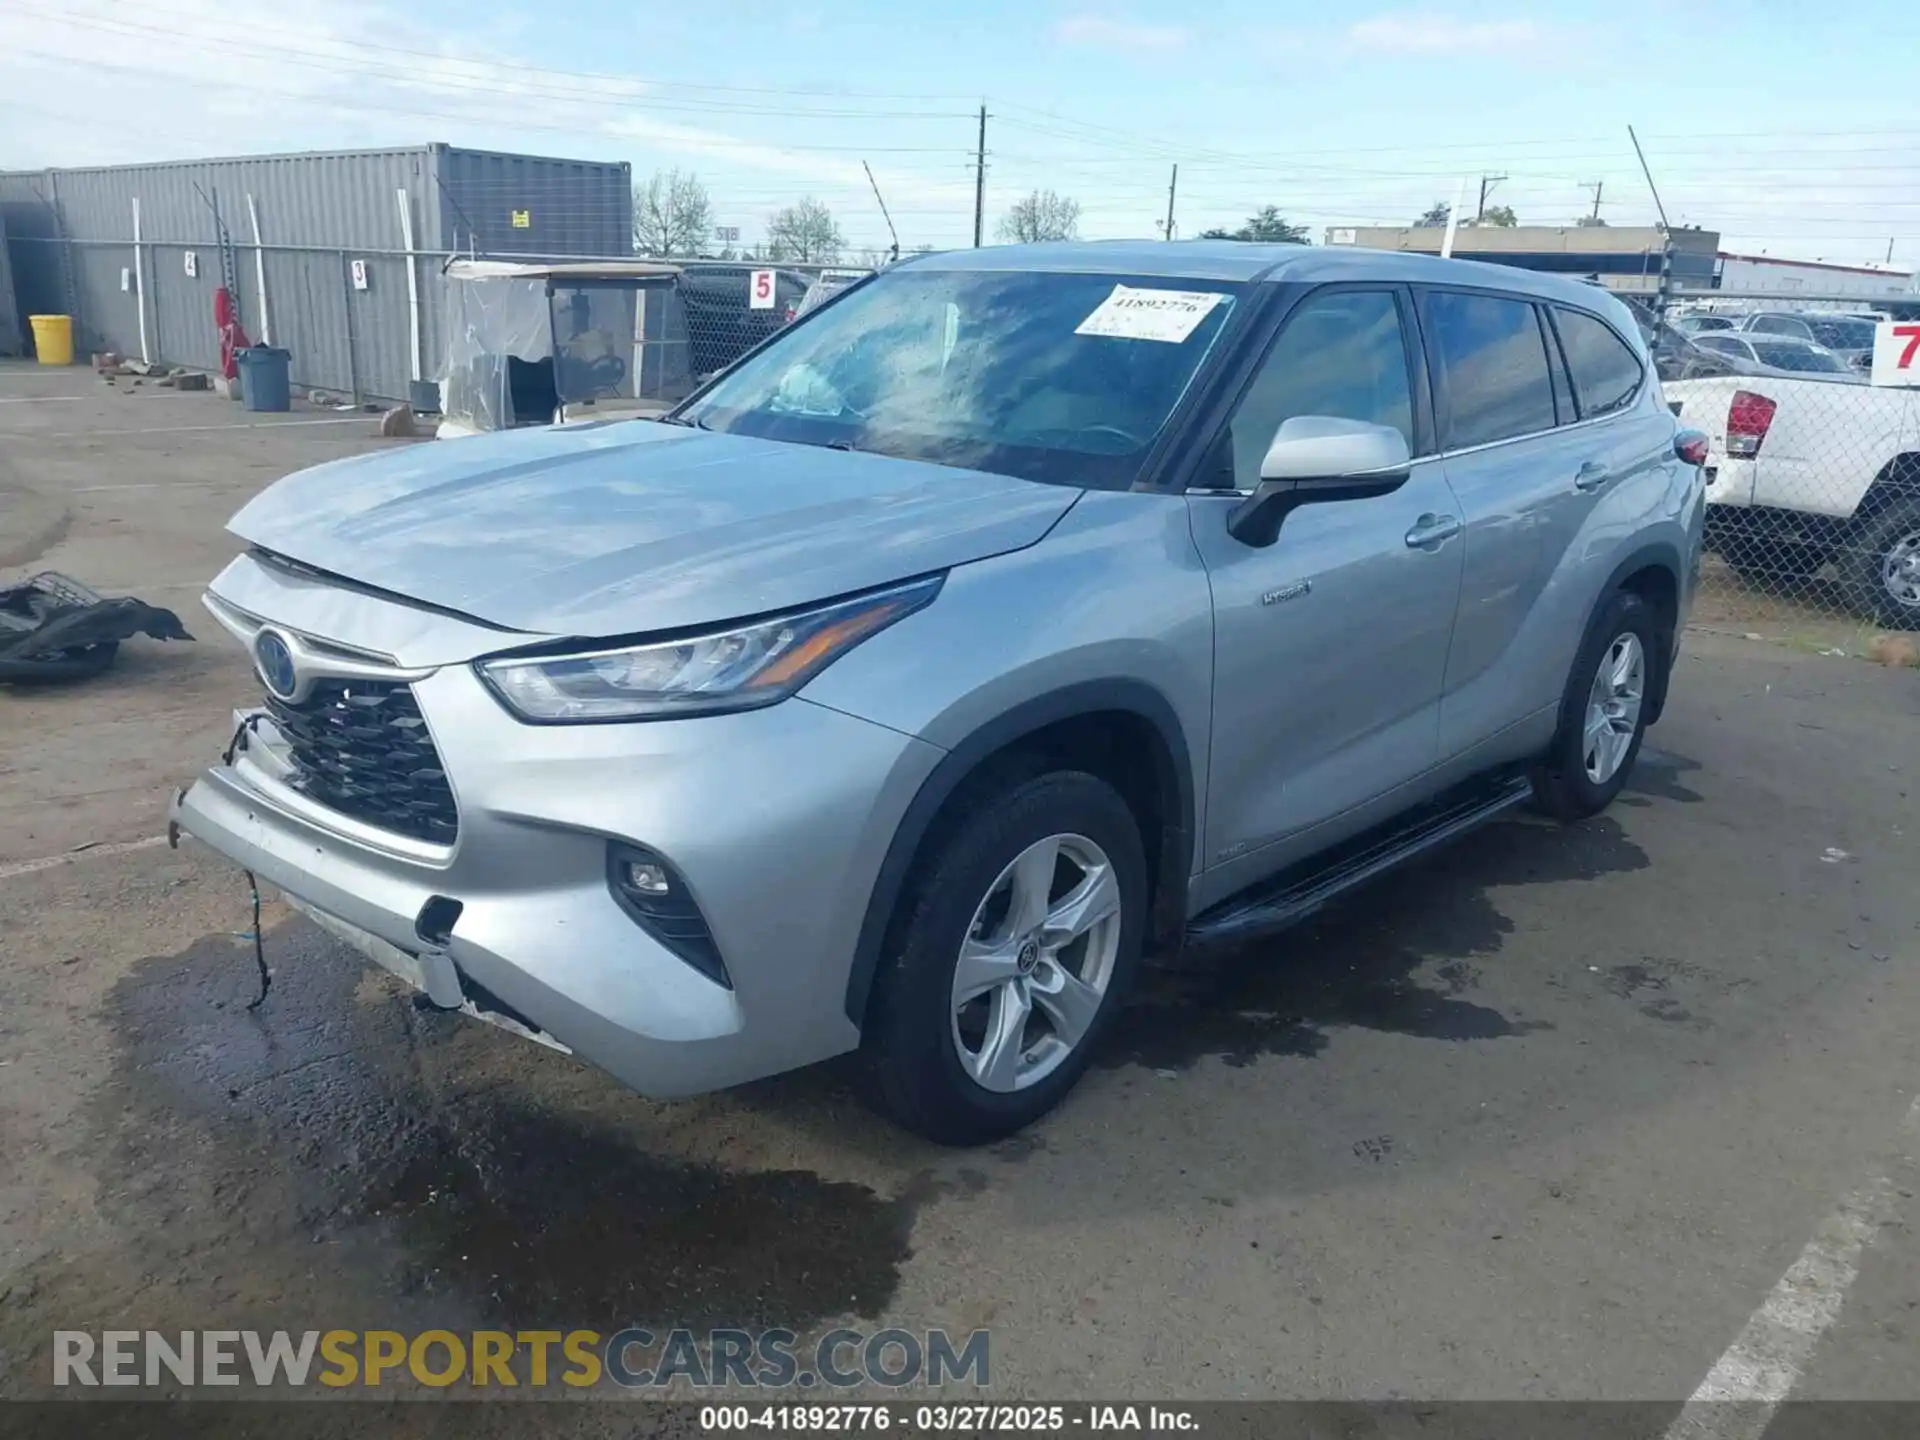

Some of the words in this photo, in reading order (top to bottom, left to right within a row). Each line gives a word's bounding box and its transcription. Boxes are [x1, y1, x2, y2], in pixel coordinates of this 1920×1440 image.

[355, 262, 363, 281] 3
[757, 273, 770, 298] 5
[1113, 298, 1198, 313] 41892776
[1893, 326, 1920, 369] 7
